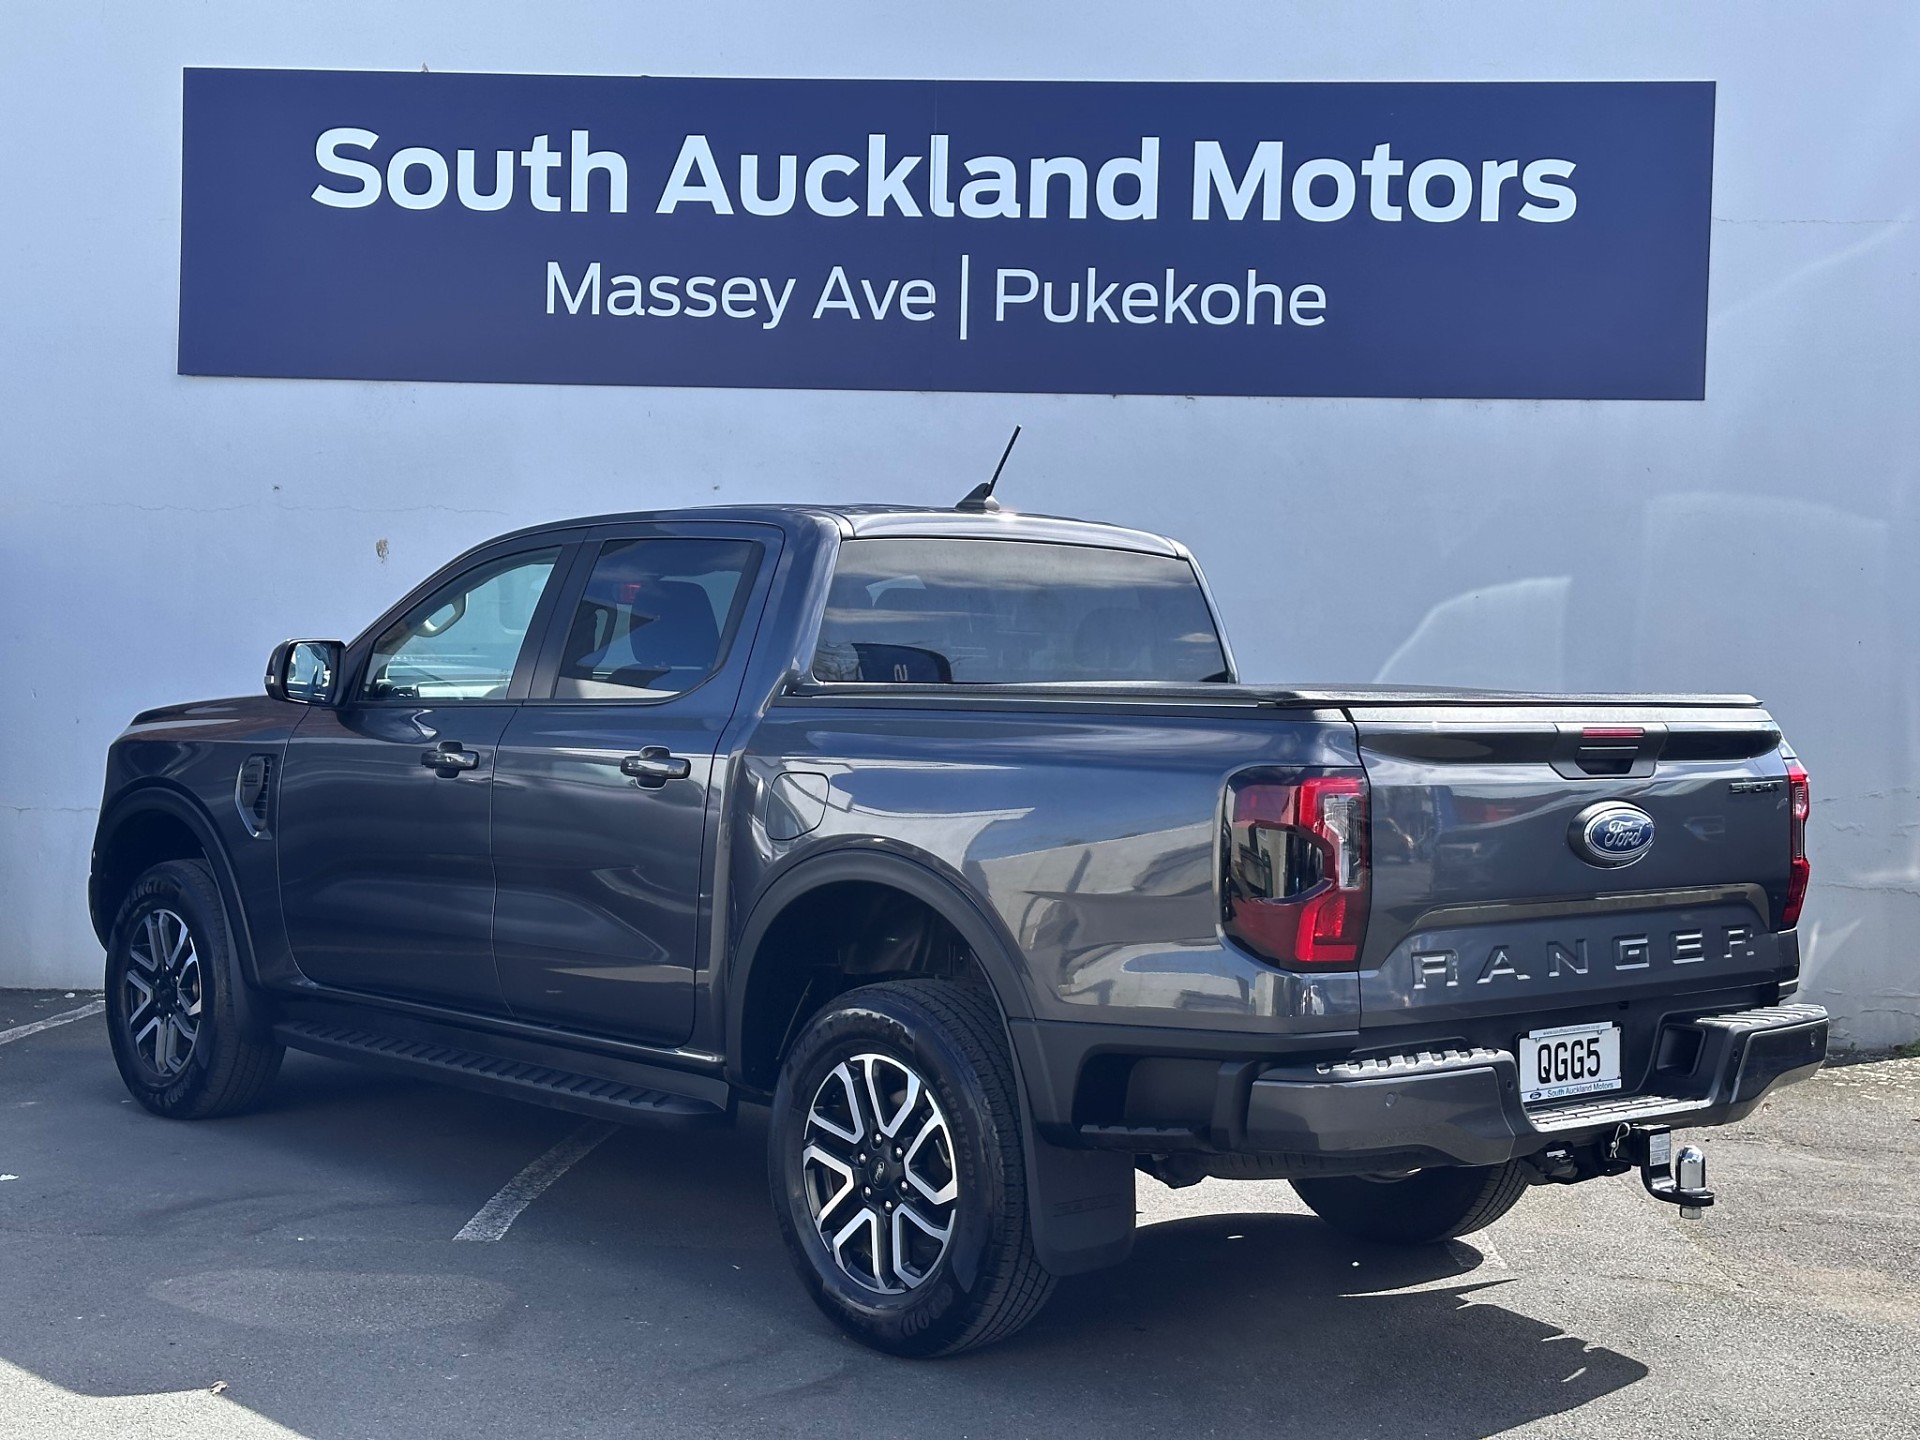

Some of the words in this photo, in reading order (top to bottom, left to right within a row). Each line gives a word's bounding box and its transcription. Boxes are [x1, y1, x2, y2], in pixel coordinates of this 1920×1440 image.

[311, 128, 628, 213] South
[656, 134, 1159, 221] Auckland
[1193, 141, 1577, 223] Motors
[546, 262, 797, 330] Massey
[812, 266, 936, 321] Ave
[995, 267, 1327, 327] Pukekohe
[1605, 820, 1642, 847] Ford
[1411, 924, 1756, 990] RANGER
[1537, 1037, 1601, 1085] QGG5
[1547, 1087, 1565, 1098] South
[1566, 1083, 1592, 1095] Auckland
[1593, 1081, 1614, 1091] Motors
